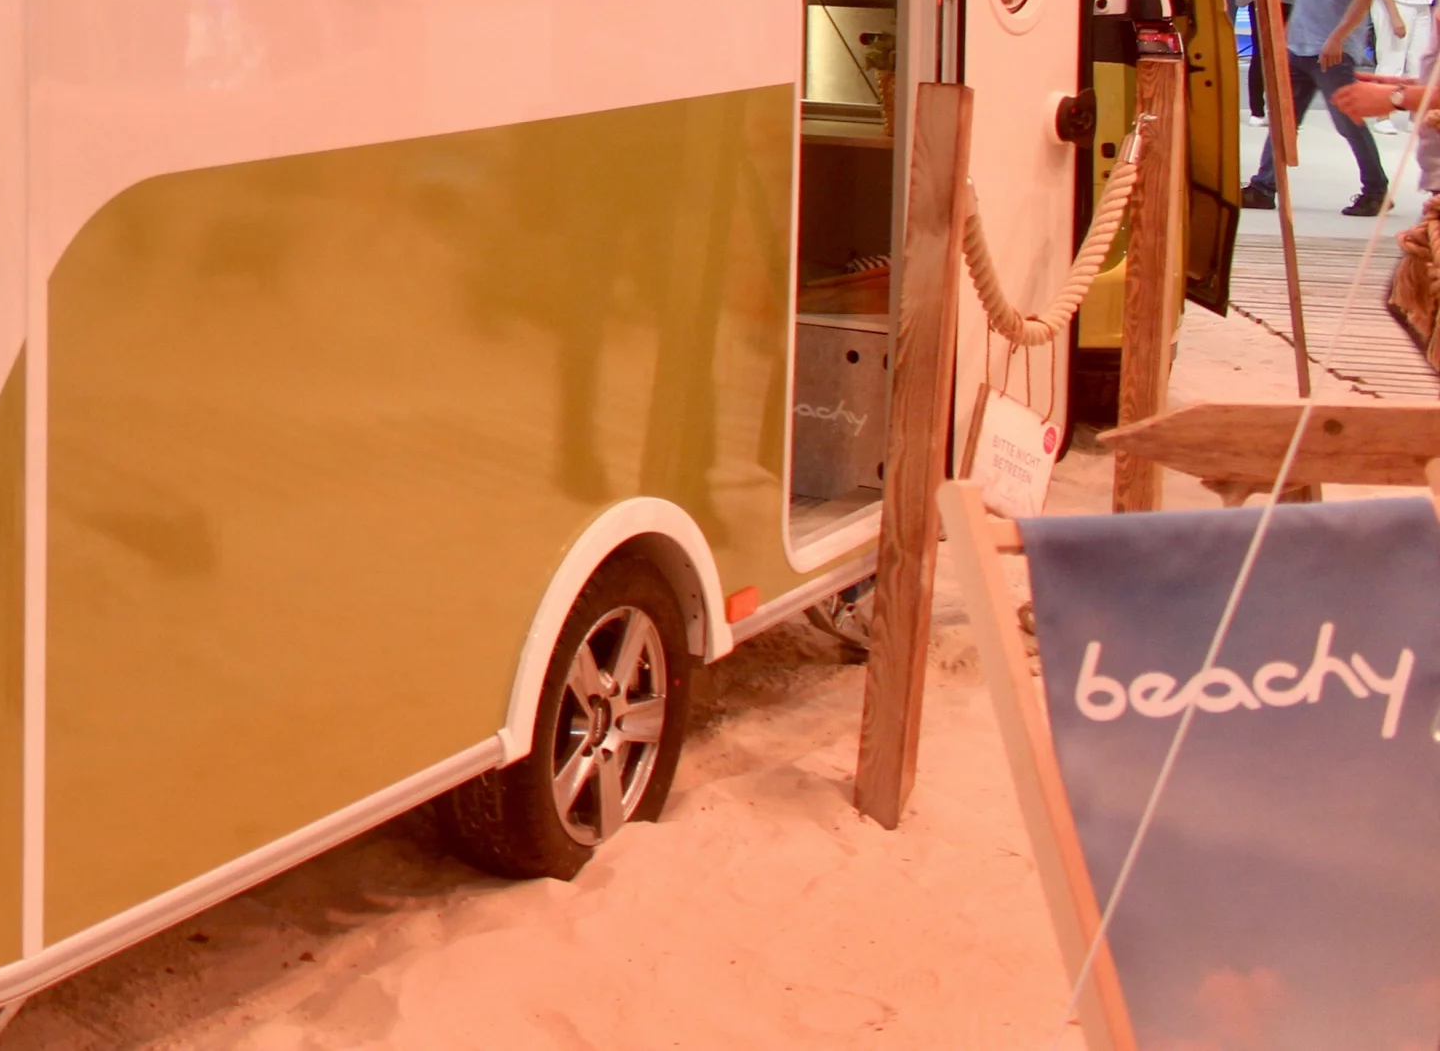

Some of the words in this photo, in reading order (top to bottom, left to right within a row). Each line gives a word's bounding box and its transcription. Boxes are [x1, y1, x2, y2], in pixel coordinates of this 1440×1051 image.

[993, 435, 1016, 457] BITTE
[1016, 448, 1041, 467] NICHT
[993, 454, 1033, 484] BETRETEN
[1075, 622, 1415, 739] beachy
